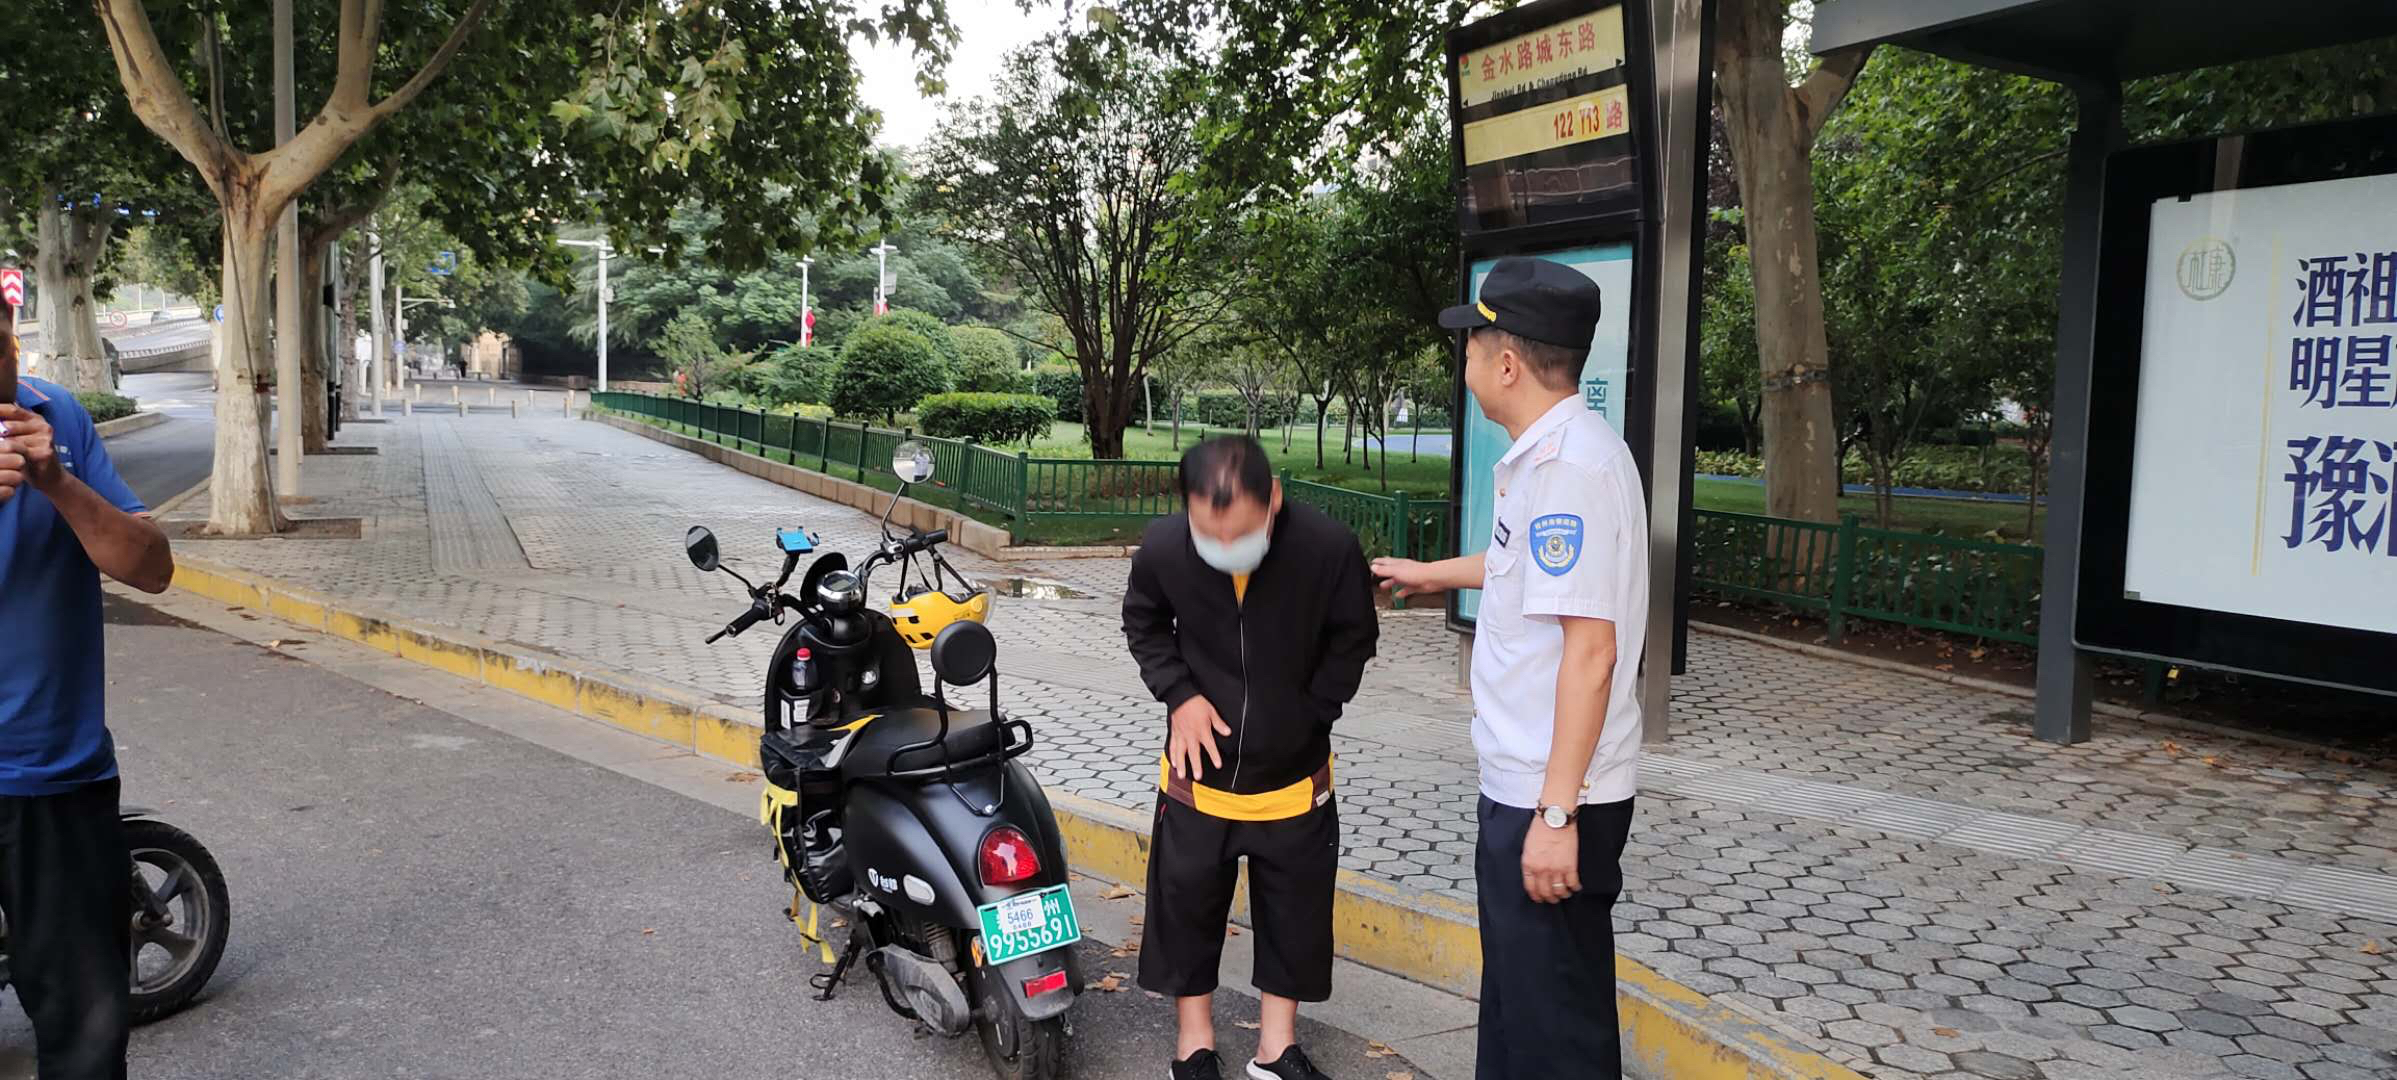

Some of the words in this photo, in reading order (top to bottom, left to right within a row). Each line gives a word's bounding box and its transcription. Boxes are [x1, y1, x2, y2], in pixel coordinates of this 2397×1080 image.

[1481, 21, 1596, 81] 金水路城东路
[1553, 110, 1574, 141] 122
[1606, 99, 1622, 129] 路
[2292, 251, 2397, 328] 酒祖
[2289, 335, 2397, 410] 明星
[990, 914, 1073, 958] 9955691
[1008, 908, 1034, 925] 5466
